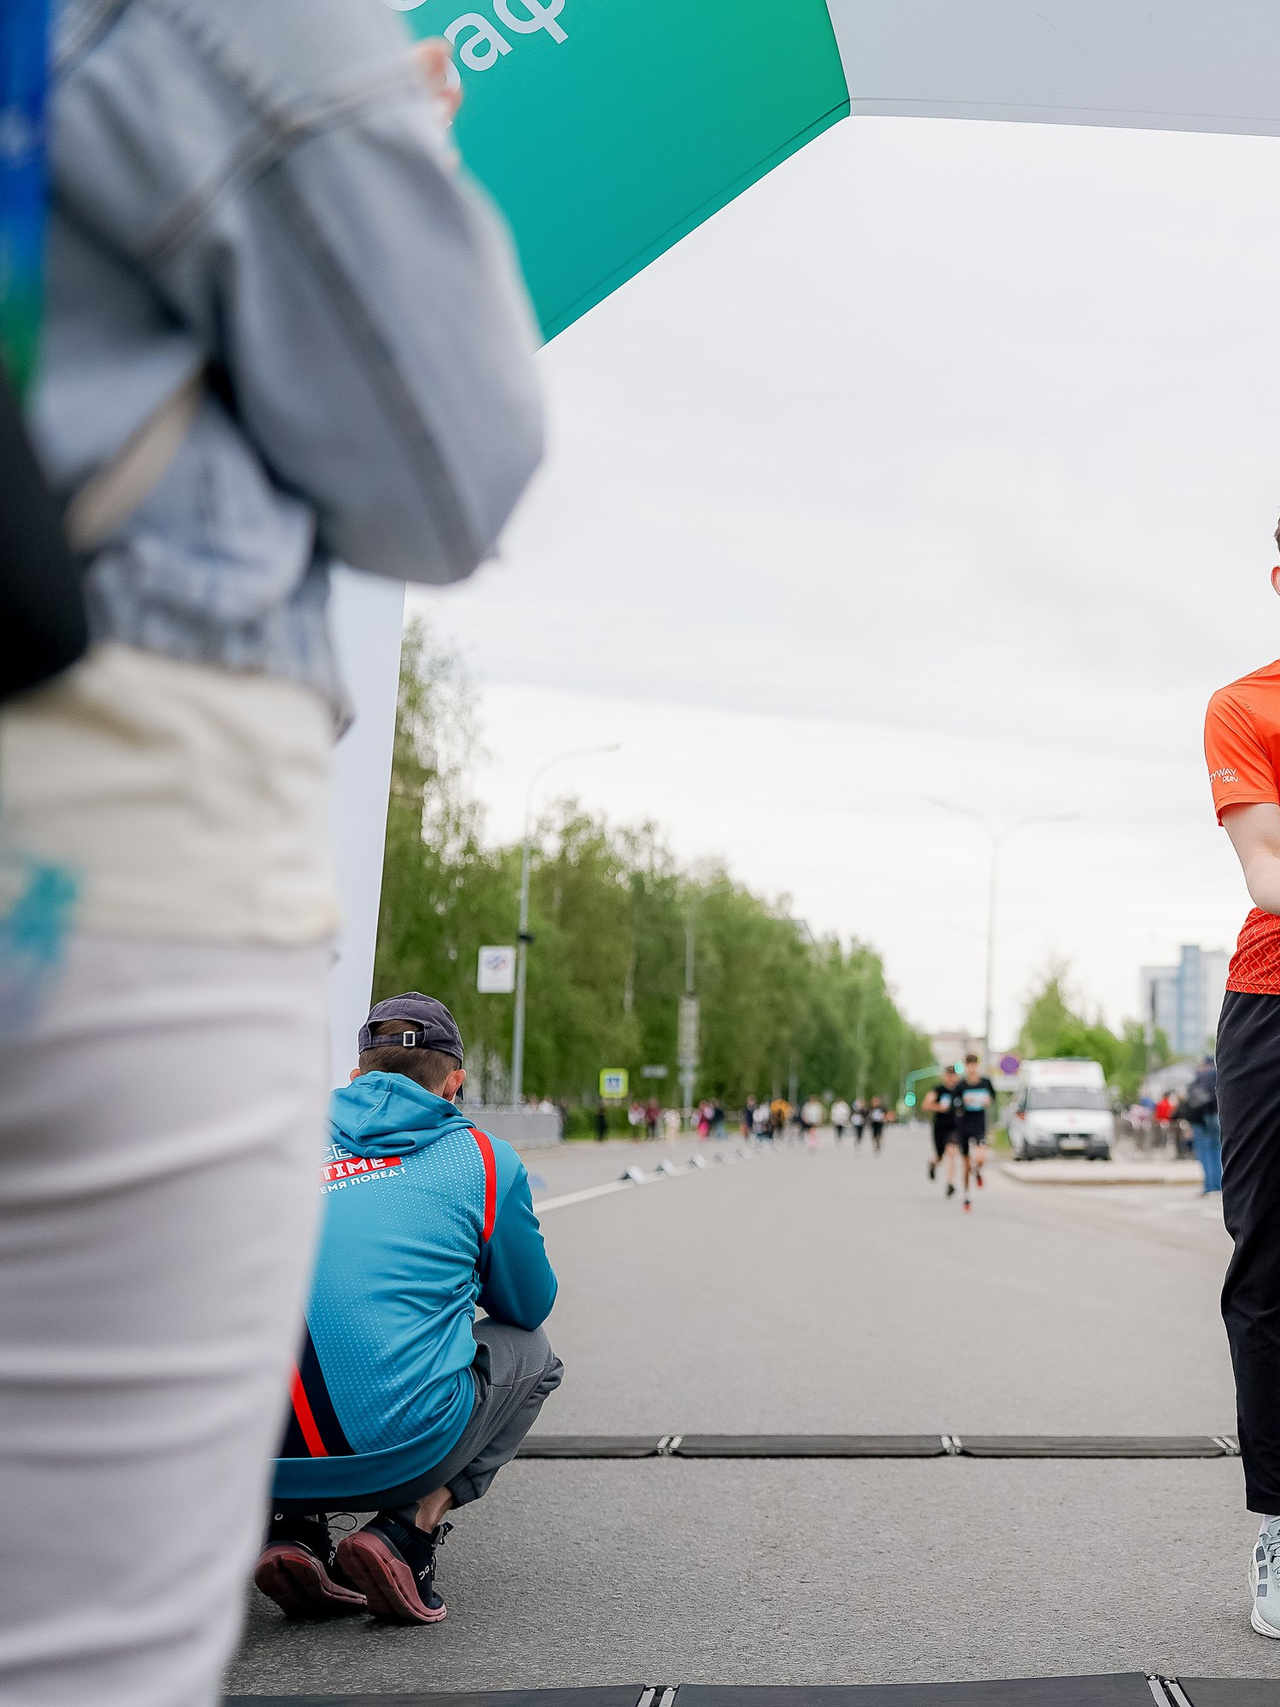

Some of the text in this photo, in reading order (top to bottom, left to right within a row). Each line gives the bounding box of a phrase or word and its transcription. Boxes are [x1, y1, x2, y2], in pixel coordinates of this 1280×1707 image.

[1222, 775, 1239, 784] RUN
[319, 1157, 387, 1181] TIME
[318, 1180, 348, 1195] ЕМЯ
